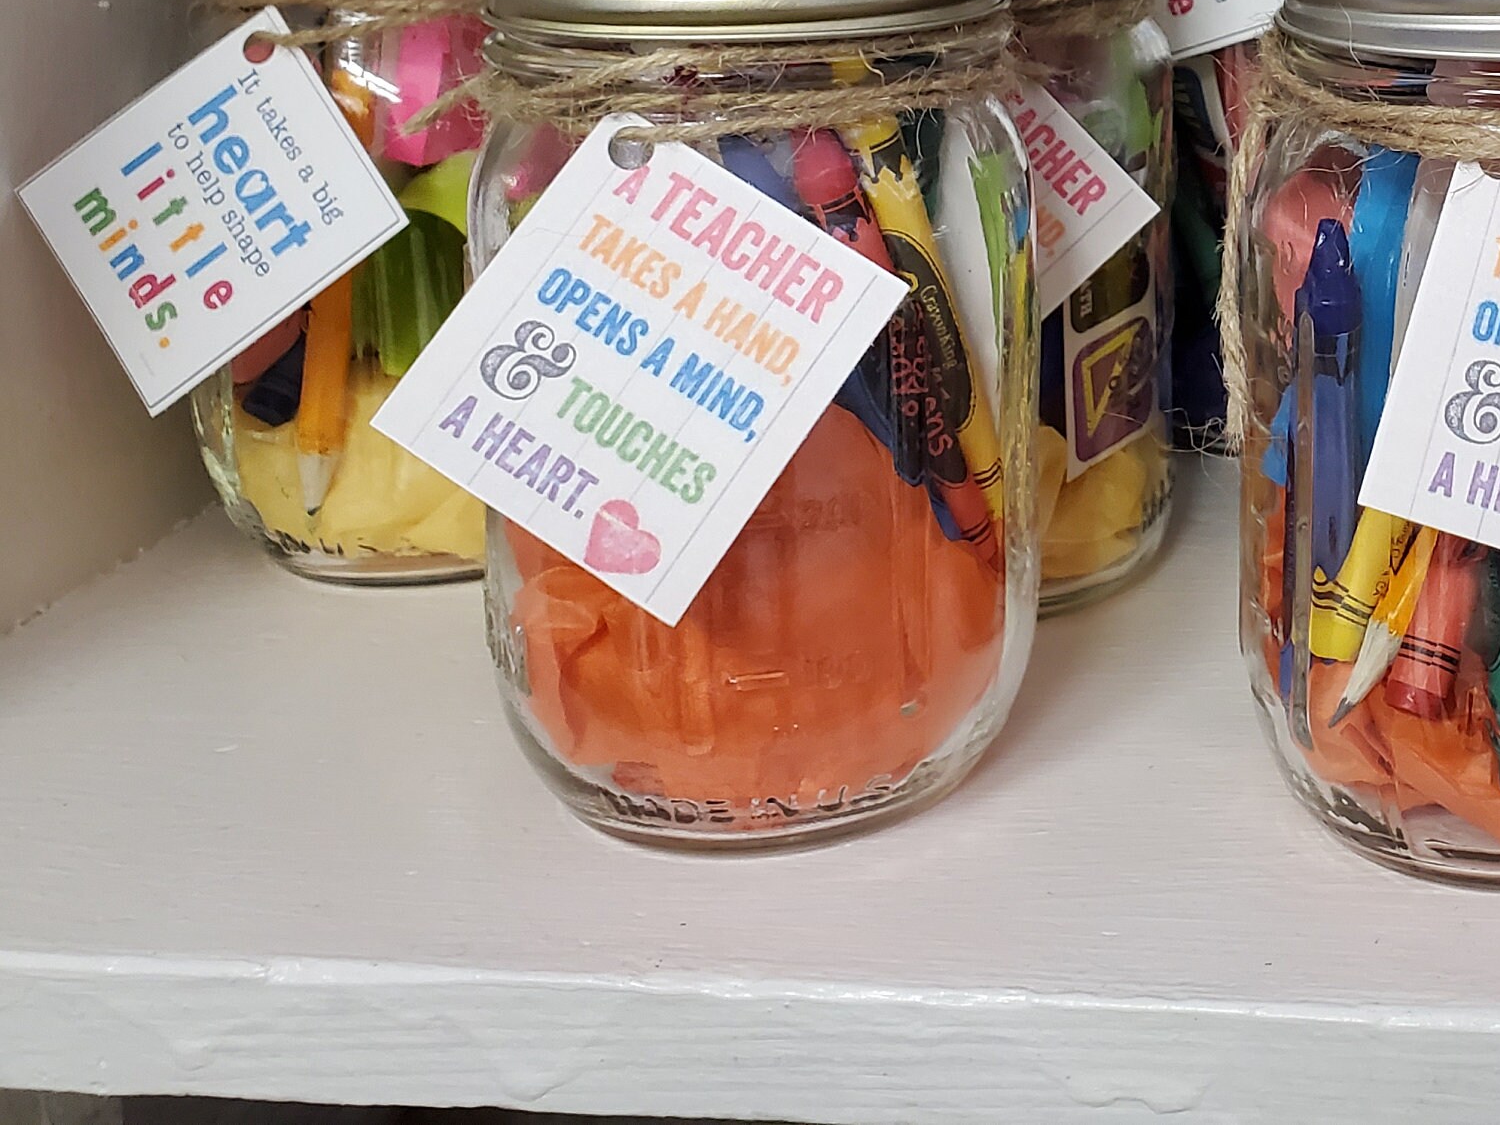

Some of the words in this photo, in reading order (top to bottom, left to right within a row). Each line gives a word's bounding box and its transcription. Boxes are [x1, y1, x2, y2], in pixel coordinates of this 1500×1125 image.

[120, 141, 234, 311] little
[167, 122, 190, 151] to
[186, 151, 226, 207] help
[221, 209, 271, 278] shape
[187, 84, 314, 257] heart
[237, 69, 260, 95] It
[256, 95, 302, 161] takes
[297, 163, 314, 183] a
[313, 181, 345, 225] big
[73, 186, 178, 349] minds.
[576, 214, 684, 299] TAKES
[673, 282, 709, 321] A
[702, 295, 802, 387] HAND,
[612, 165, 651, 205] A
[650, 170, 846, 324] TEACHER
[479, 319, 577, 400] &
[556, 376, 718, 505] TOUCHES
[536, 267, 649, 357] OPENS
[640, 337, 677, 377] A
[669, 351, 766, 444] MIND,
[439, 395, 478, 440] A
[472, 419, 599, 519] HEART.
[1428, 452, 1457, 498] A
